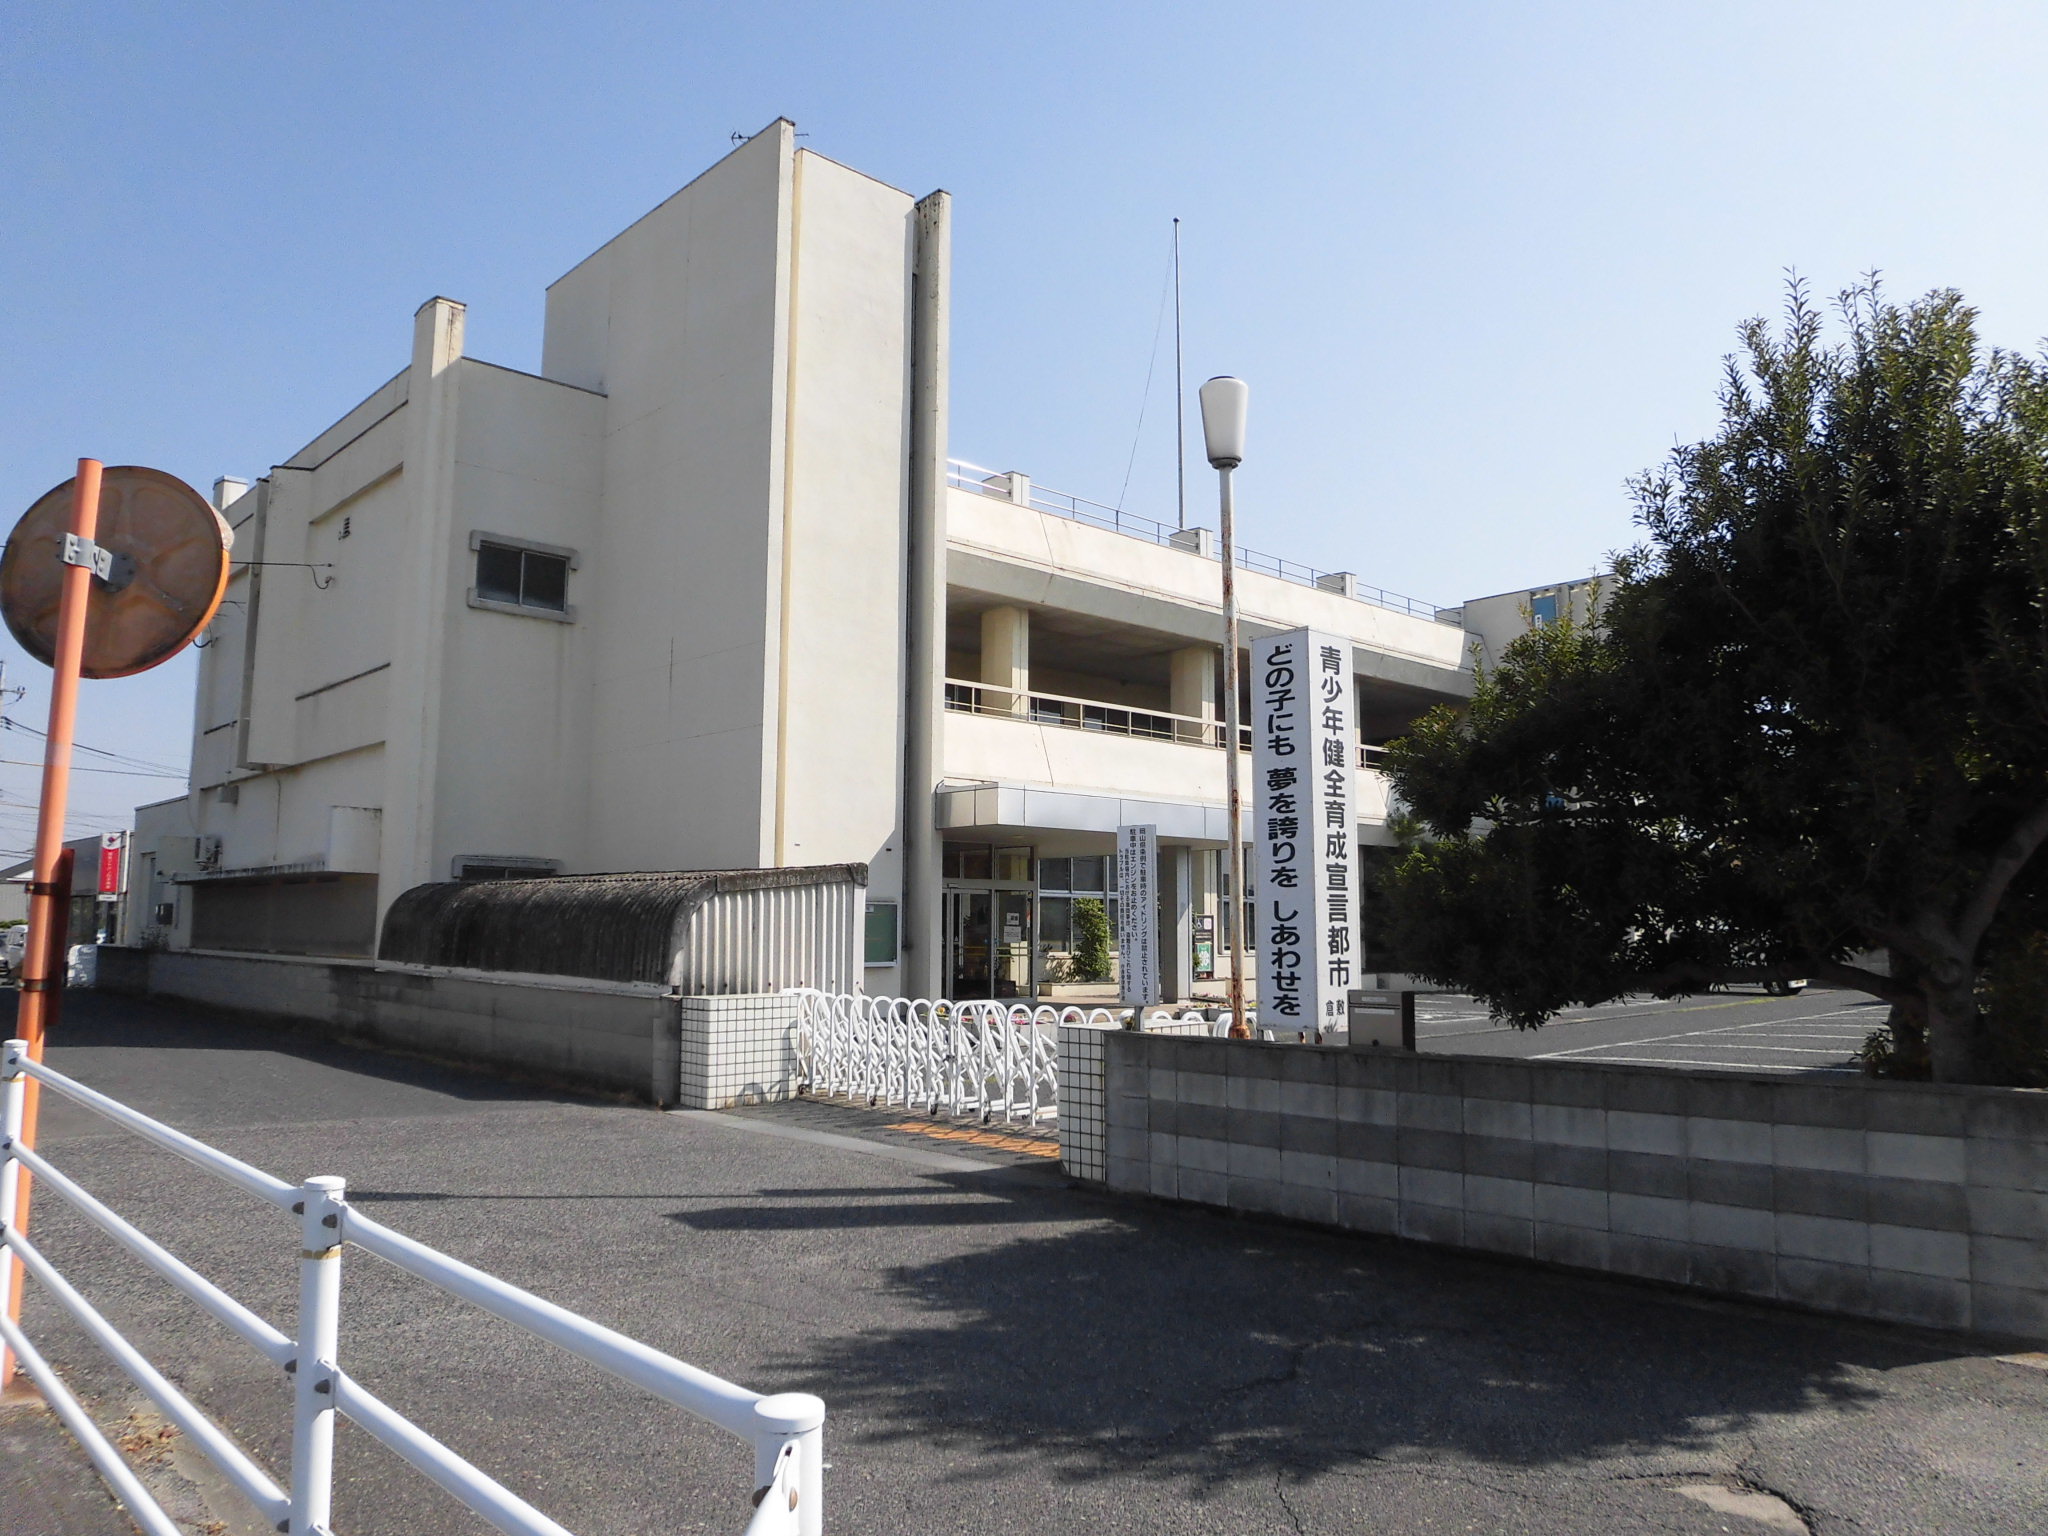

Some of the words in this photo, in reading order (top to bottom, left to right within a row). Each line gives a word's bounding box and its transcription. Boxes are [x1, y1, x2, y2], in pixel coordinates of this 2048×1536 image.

[1265, 643, 1296, 757] どの子にも
[1267, 767, 1299, 888] 夢を誇りを
[1320, 645, 1351, 987] 青少年健全育成宣言都市
[1271, 900, 1302, 1017] しあわせを
